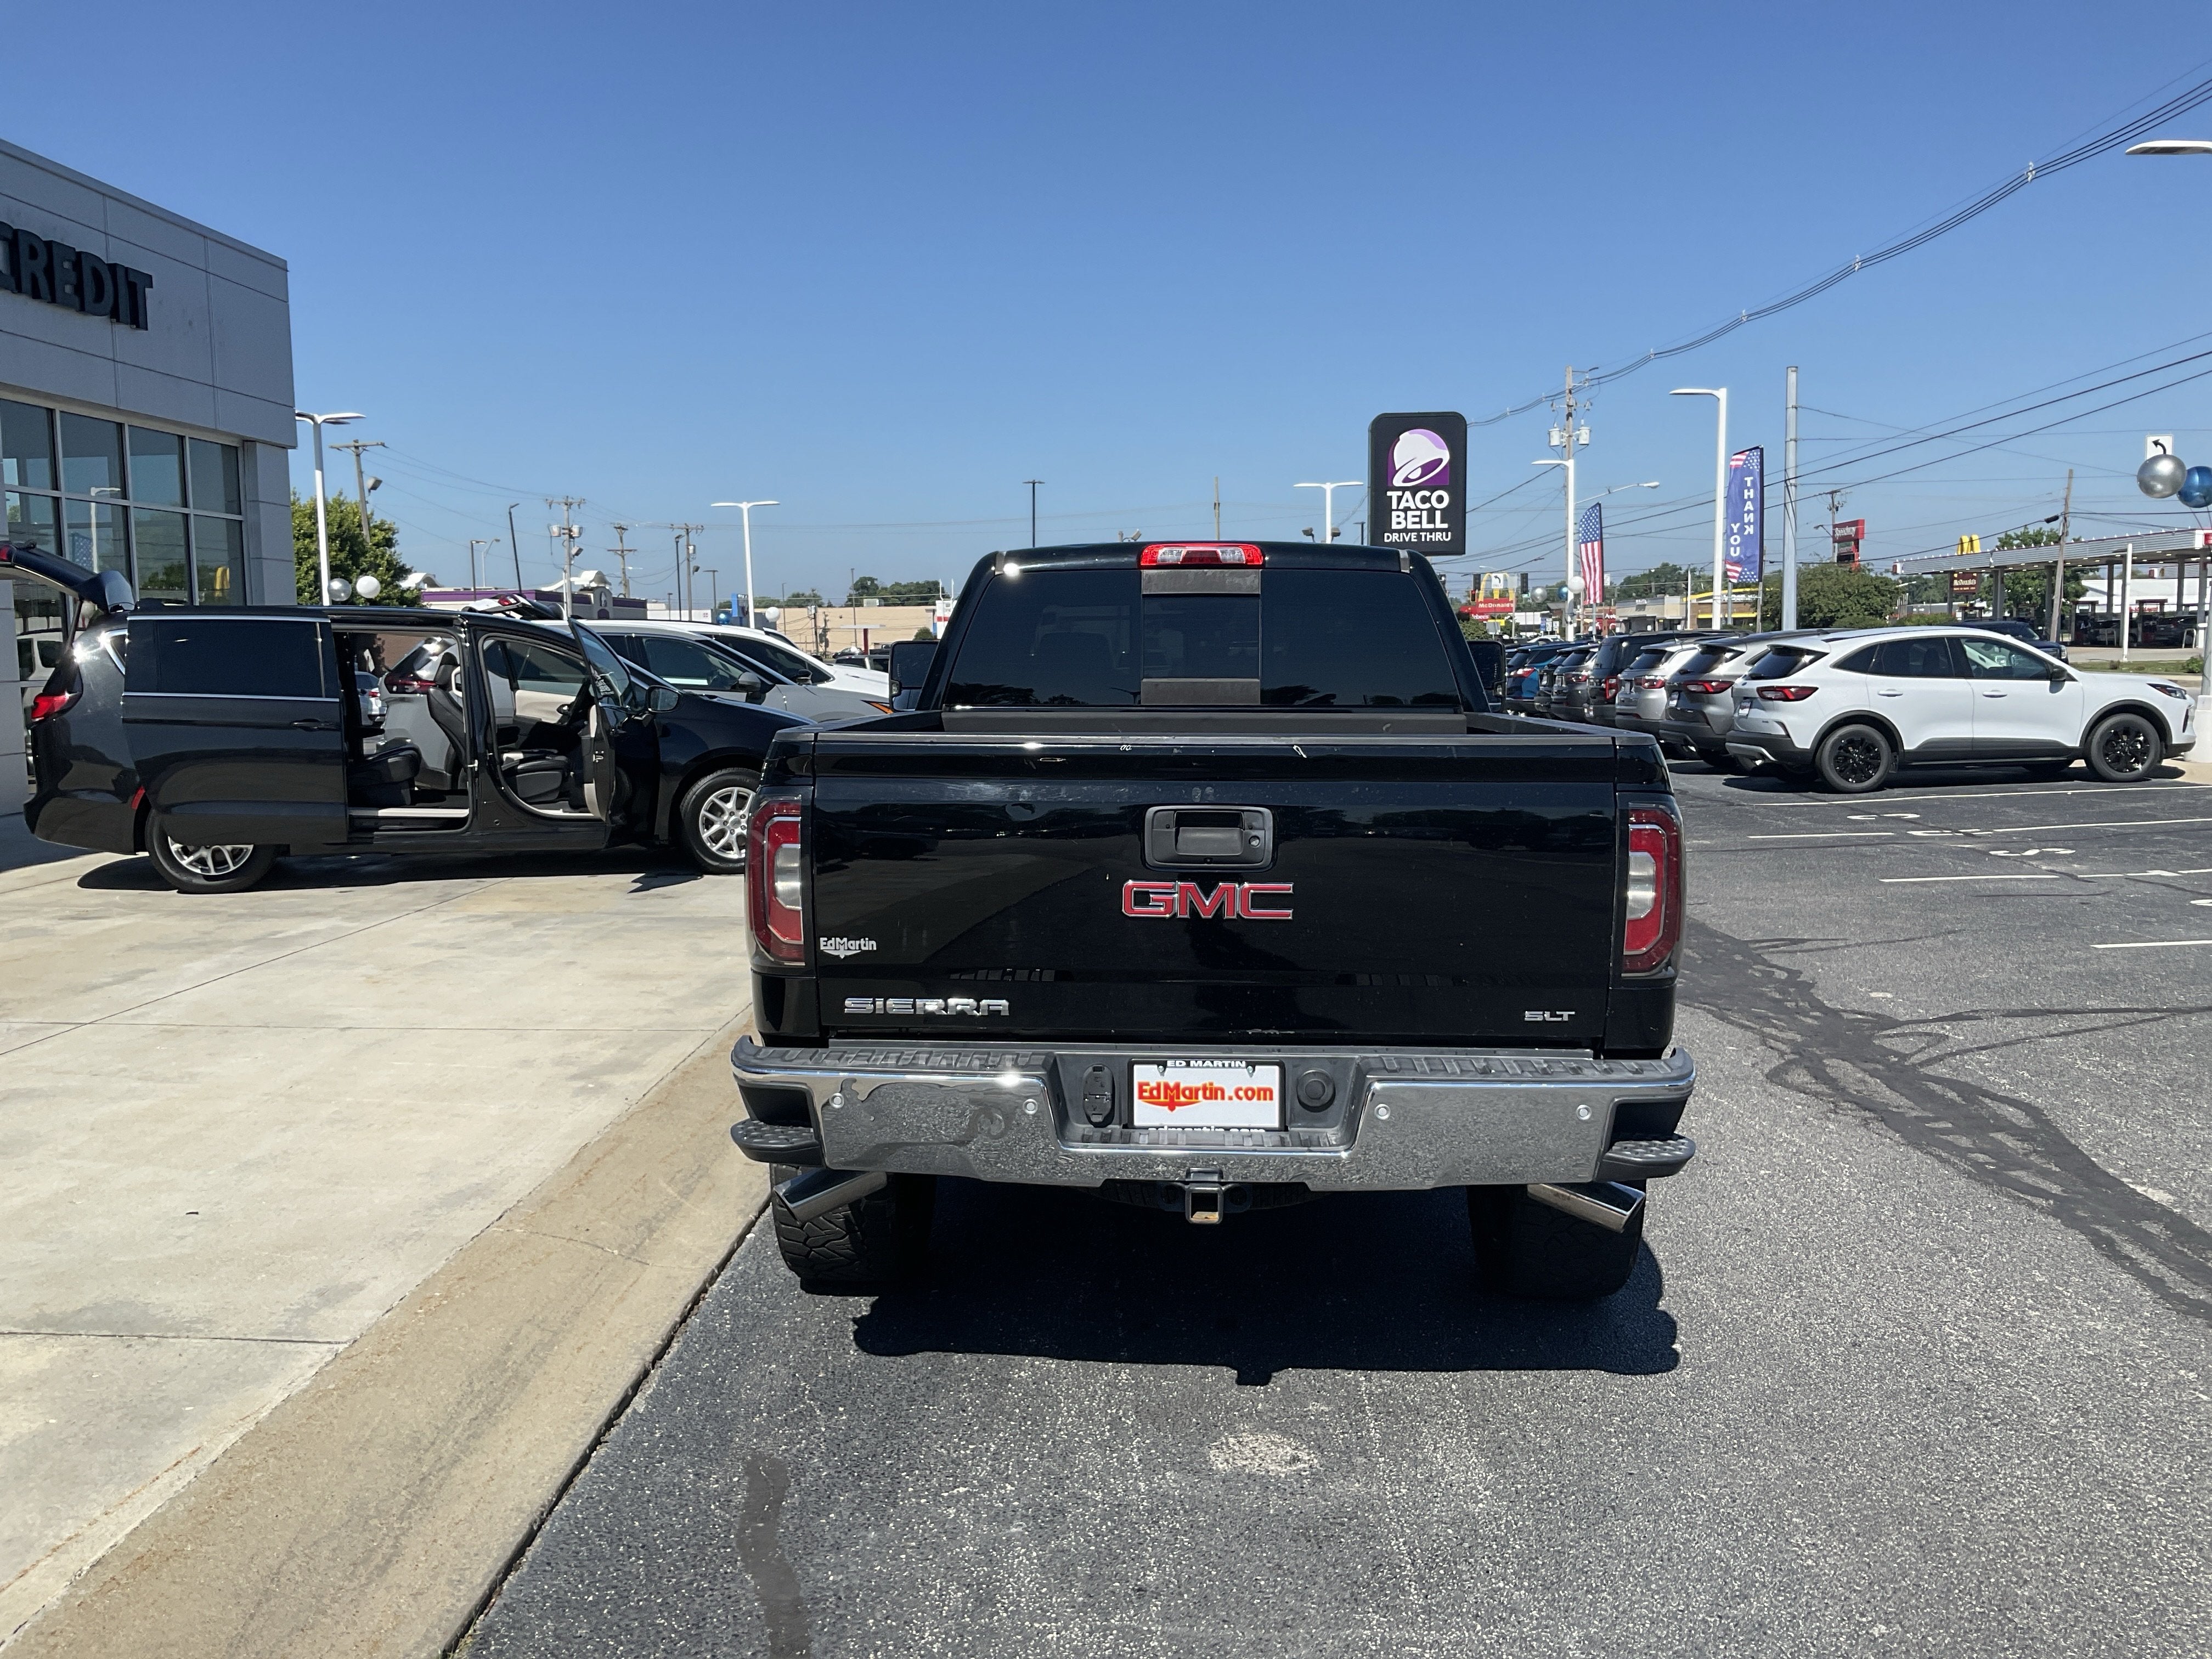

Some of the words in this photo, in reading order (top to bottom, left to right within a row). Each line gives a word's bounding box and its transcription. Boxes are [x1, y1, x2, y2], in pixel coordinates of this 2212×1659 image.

[1386, 490, 1449, 510] TACO
[1391, 510, 1448, 529] BELL
[1384, 532, 1418, 543] DRIVE
[1419, 532, 1452, 542] THRU
[1122, 880, 1294, 920] GMC
[820, 937, 877, 952] EdMartin
[844, 997, 1010, 1016] SIERRA
[1524, 1011, 1576, 1022] SLT
[1137, 1081, 1274, 1102] EdMartin.com
